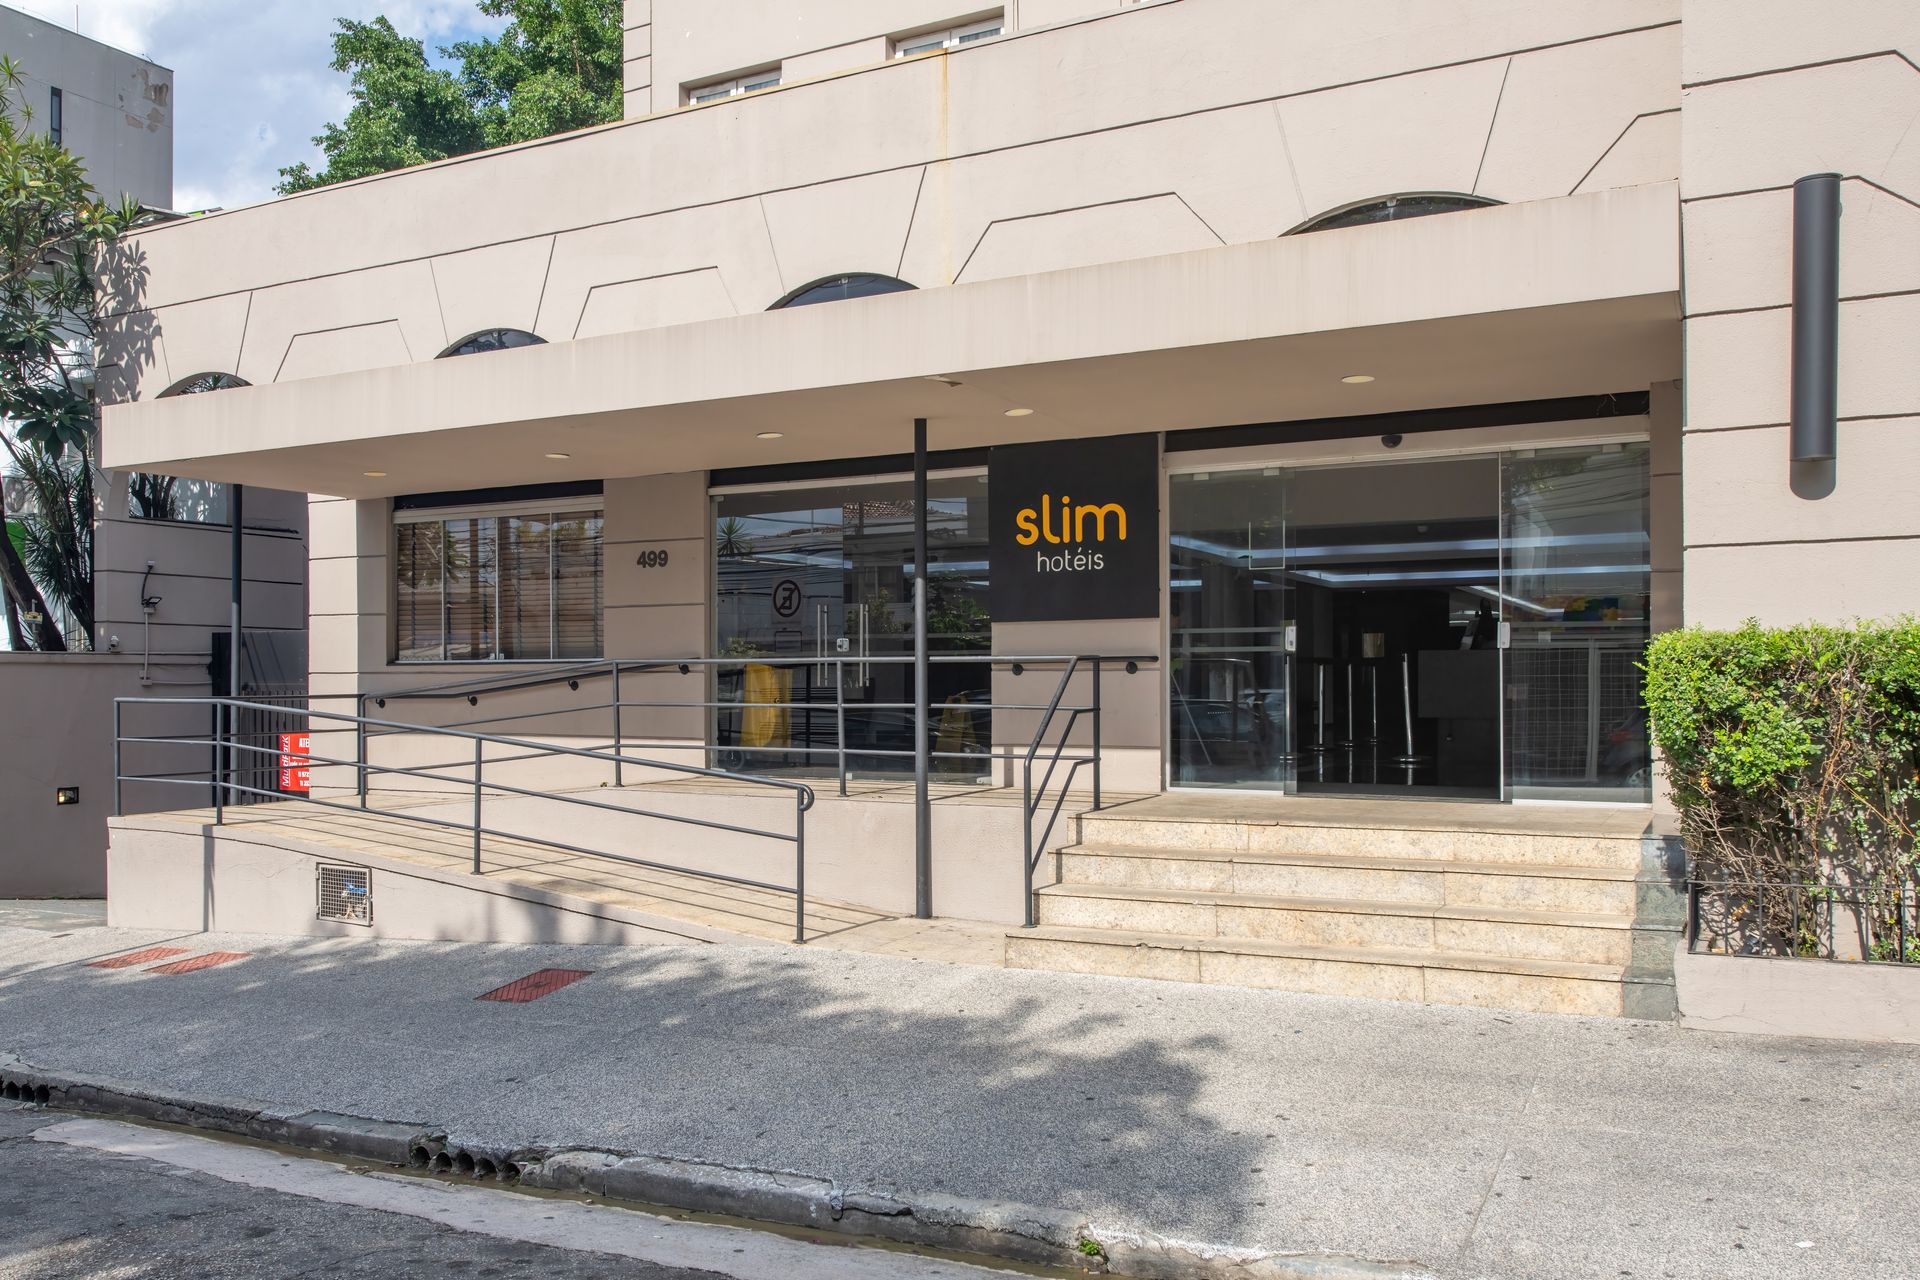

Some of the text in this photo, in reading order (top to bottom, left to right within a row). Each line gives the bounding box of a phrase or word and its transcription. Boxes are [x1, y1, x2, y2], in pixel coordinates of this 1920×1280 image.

[1016, 494, 1127, 546] slim
[637, 550, 669, 568] 499
[1037, 547, 1104, 572] hotéis
